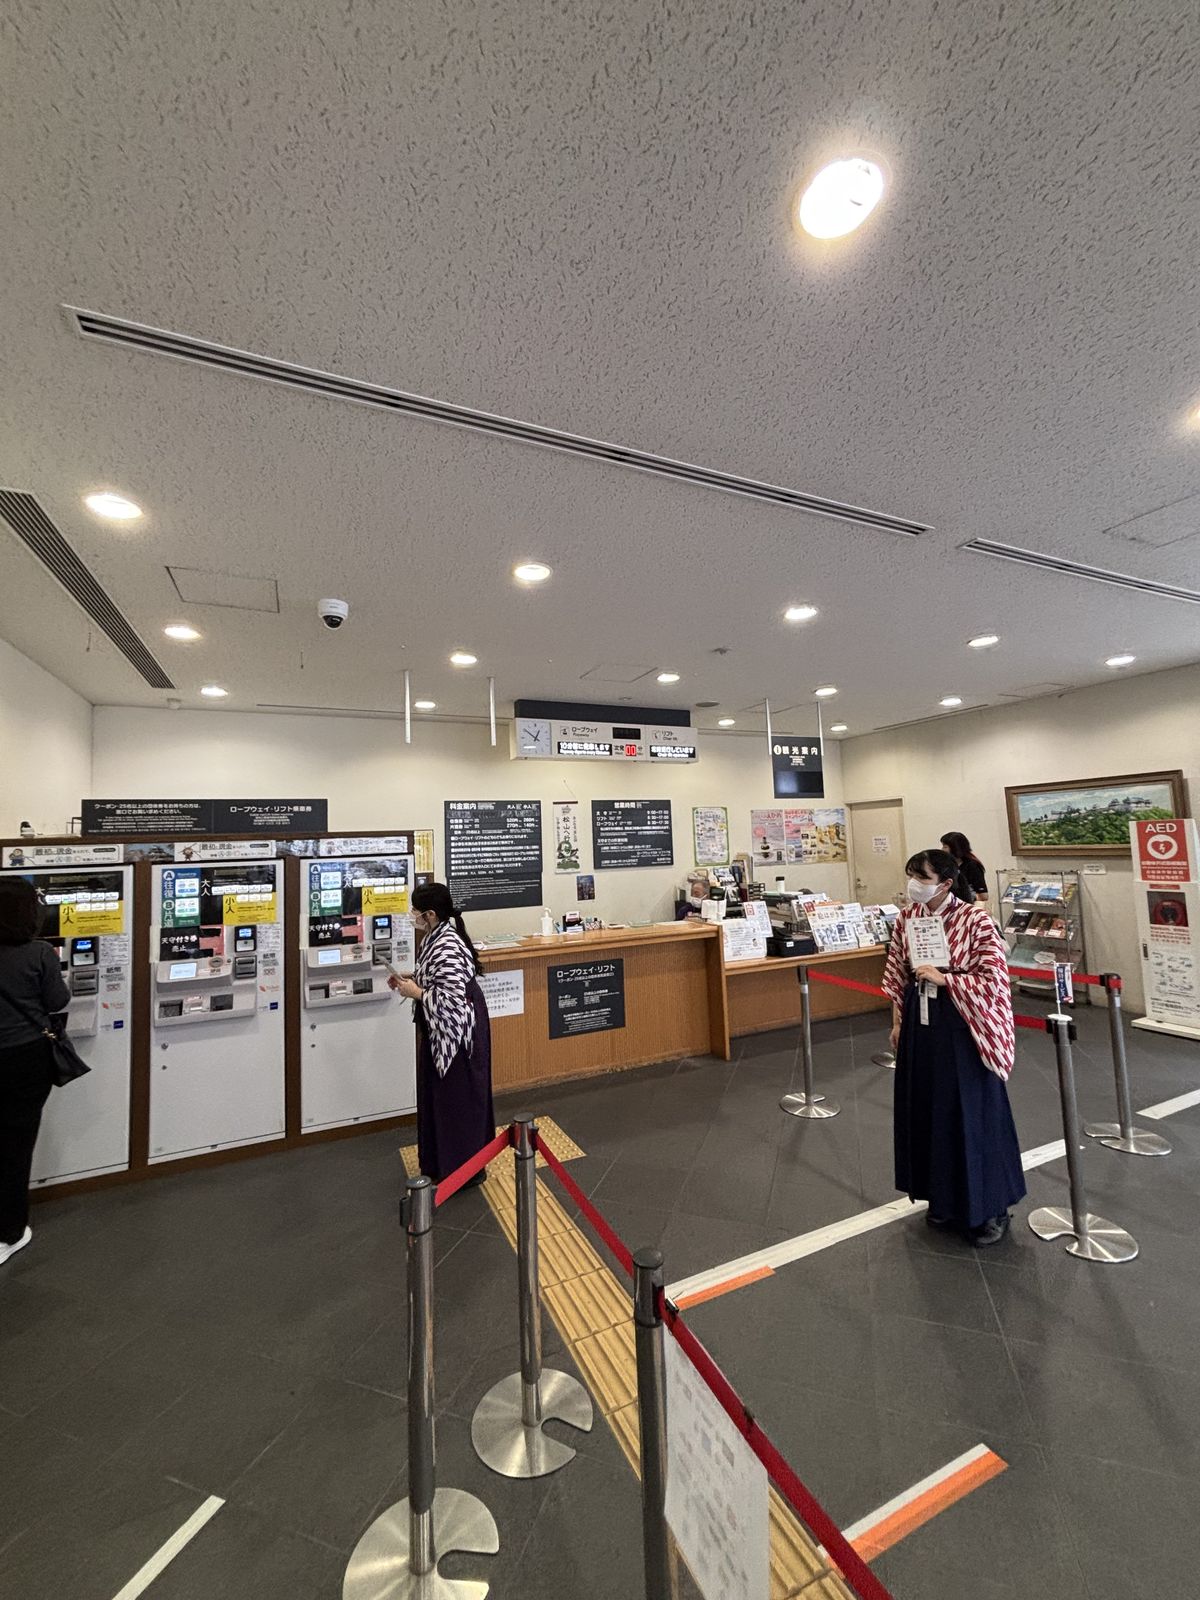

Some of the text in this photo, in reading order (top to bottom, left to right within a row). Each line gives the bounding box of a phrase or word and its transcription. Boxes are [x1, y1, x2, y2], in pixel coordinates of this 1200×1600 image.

[626, 745, 636, 756] 00
[782, 746, 818, 755] 観光案内
[449, 802, 476, 810] 料金案内
[1145, 823, 1177, 834] AED
[164, 881, 174, 898] 往復
[201, 879, 211, 897] 大人
[364, 889, 373, 905] 小人
[225, 897, 235, 914] 小人
[63, 906, 74, 924] 小人
[556, 964, 616, 978] ロープウェイ・リフト
